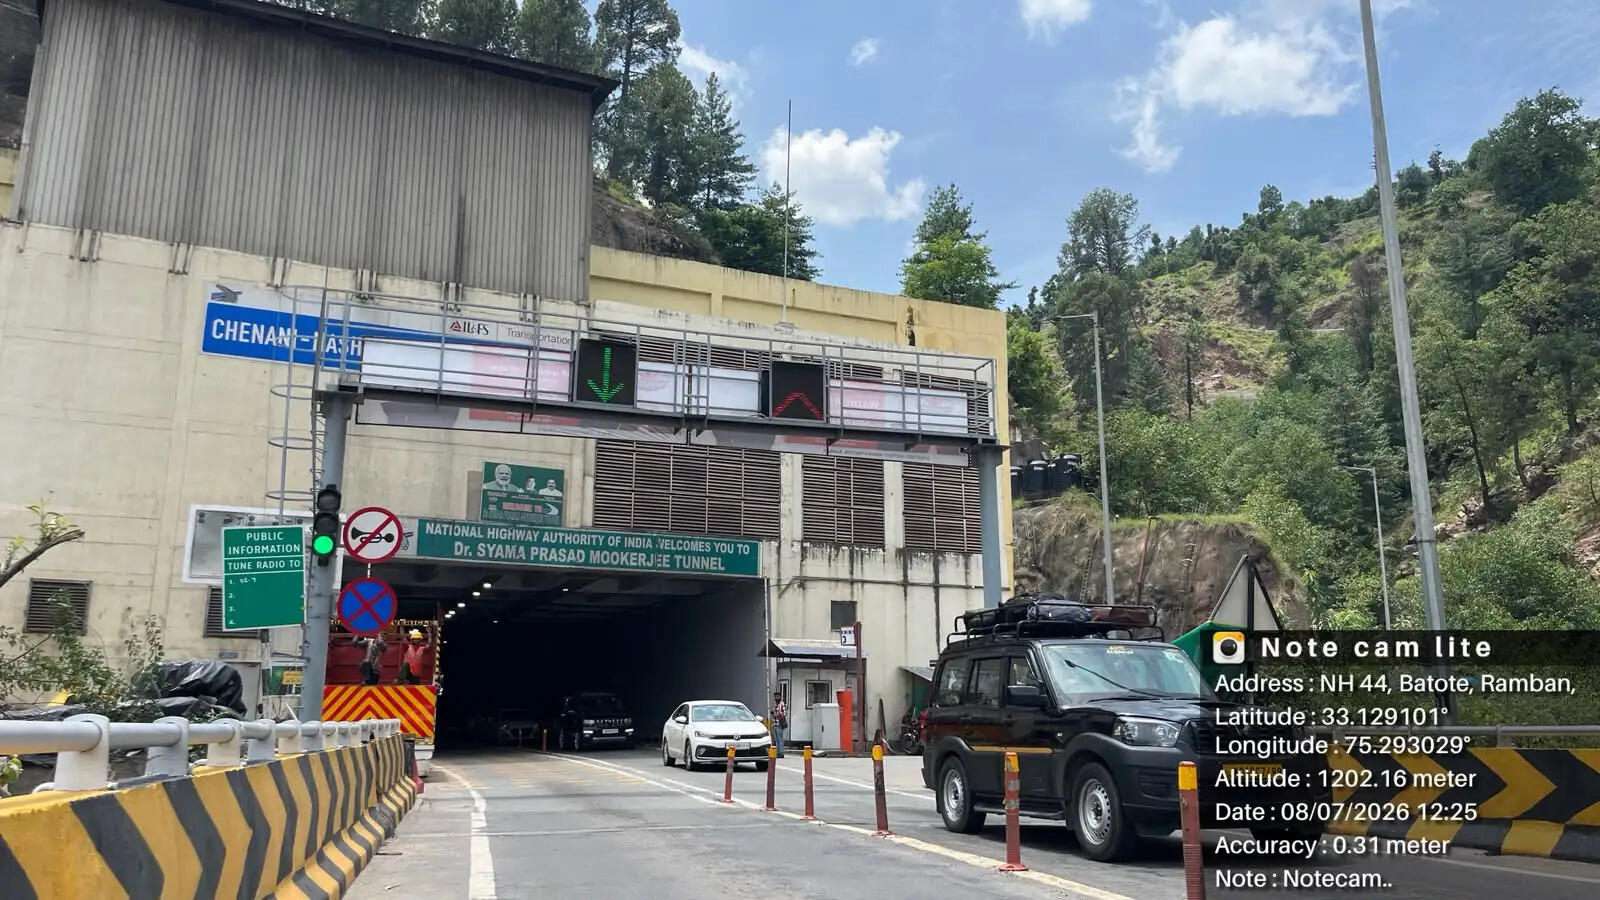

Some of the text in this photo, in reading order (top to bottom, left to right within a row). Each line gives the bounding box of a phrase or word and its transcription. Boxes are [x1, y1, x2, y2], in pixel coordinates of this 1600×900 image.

[246, 532, 284, 541] PUBLIC
[425, 522, 750, 555] NATIONAL HIGHWAY AUTHORITY OF INDIA WELCOMES YOU TO
[228, 544, 301, 555] INFORMATION
[454, 541, 725, 571] Dr. SYAMA PRASAD MOOKERJEE TUNNEL
[228, 559, 301, 571] TUNE RADIO TO
